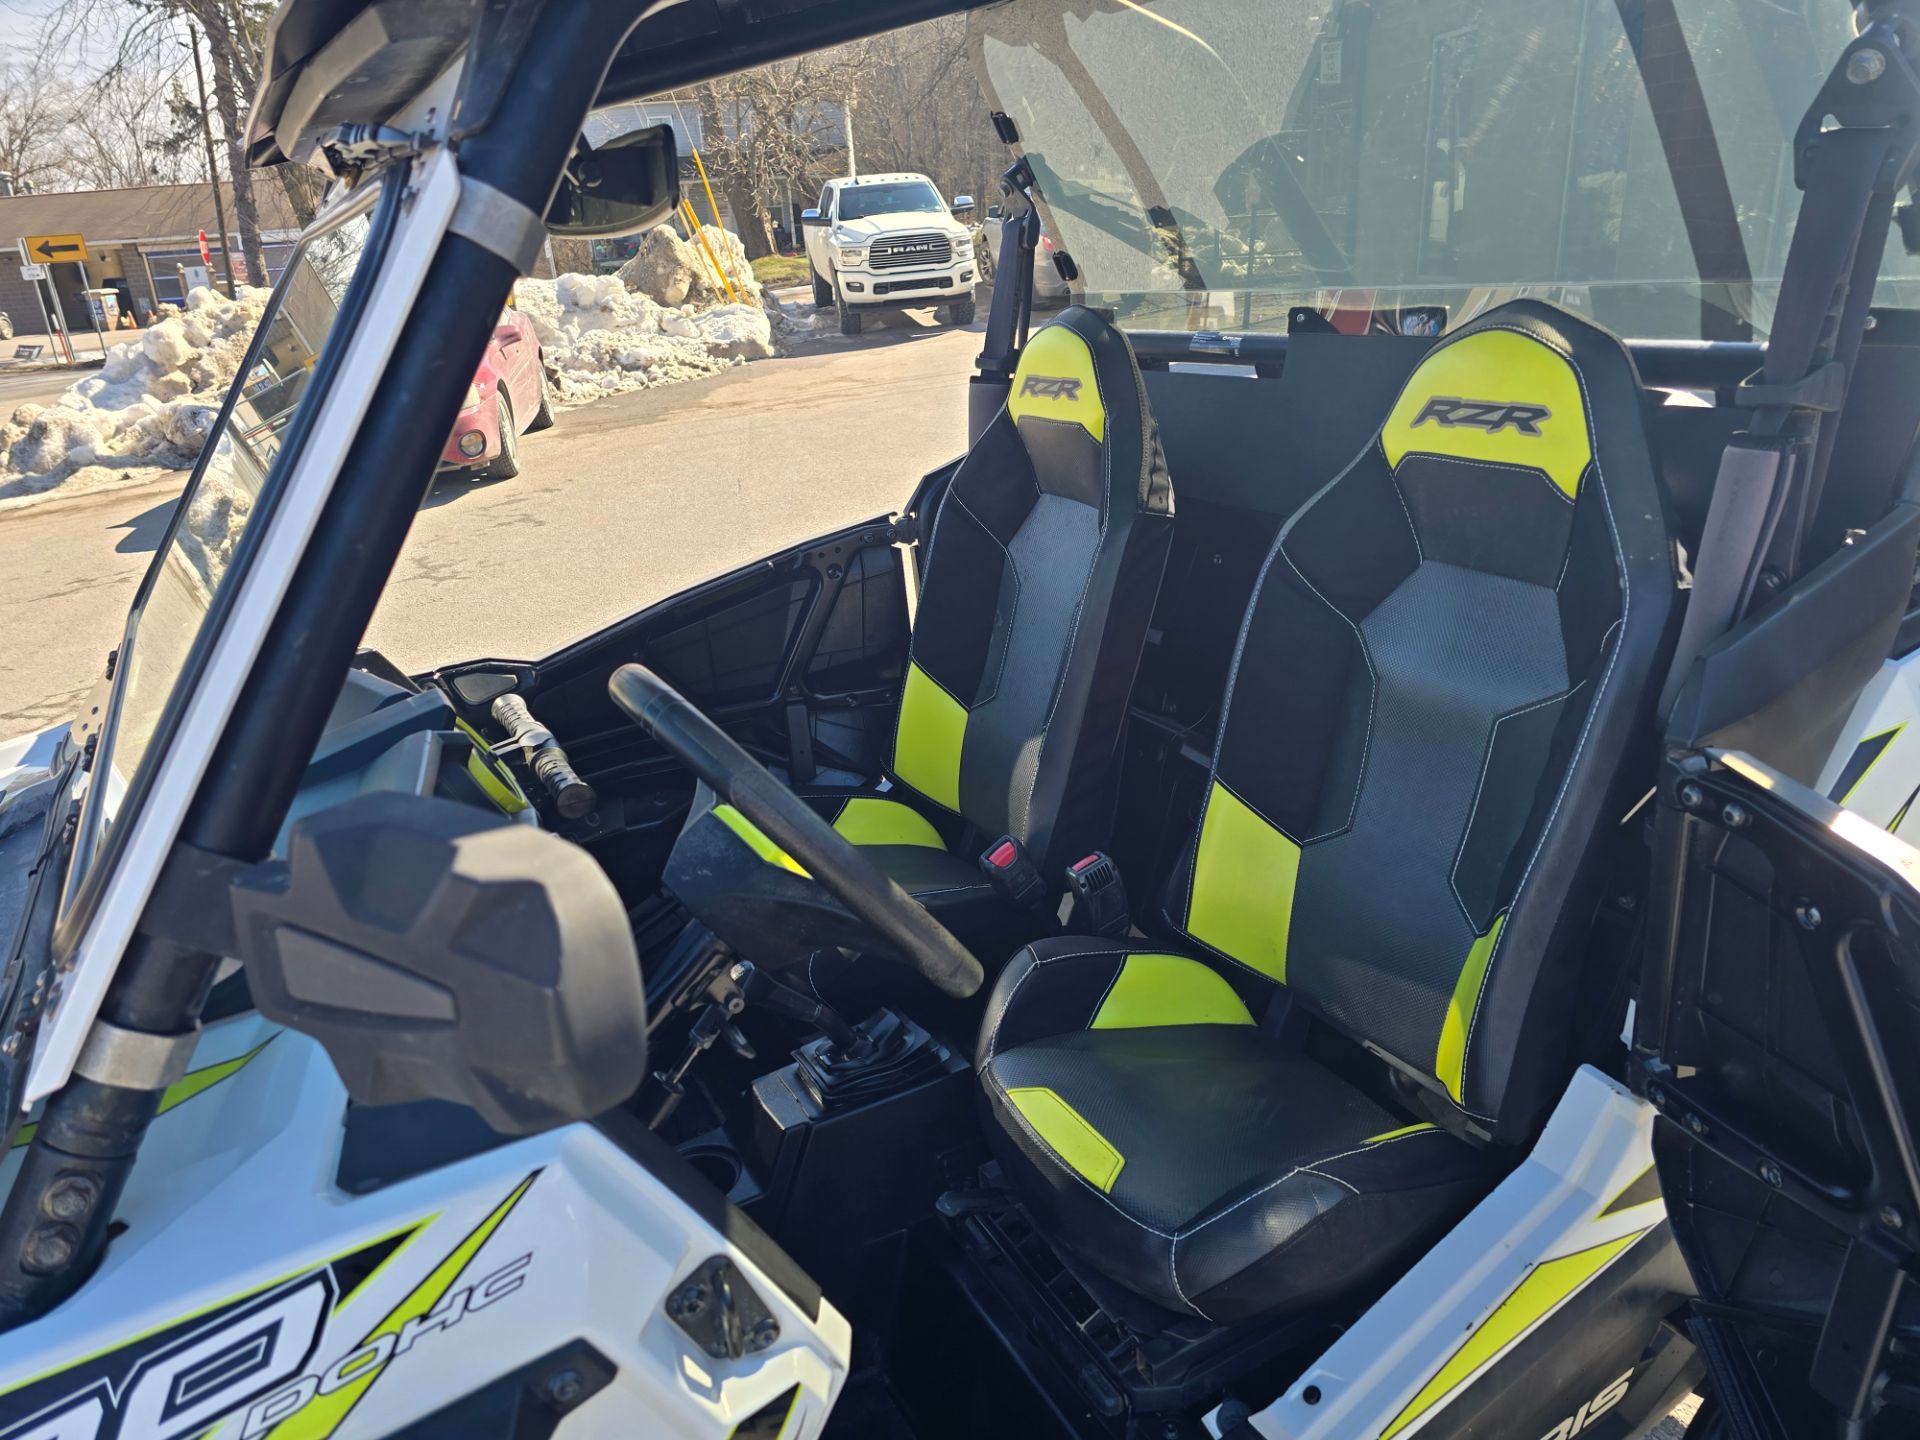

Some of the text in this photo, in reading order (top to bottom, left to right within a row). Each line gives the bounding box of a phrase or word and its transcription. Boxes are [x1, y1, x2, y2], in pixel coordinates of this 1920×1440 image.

[893, 244, 928, 253] RAM
[1019, 375, 1082, 401] RZR
[1410, 396, 1552, 437] RZR
[240, 1251, 533, 1440] DOHC
